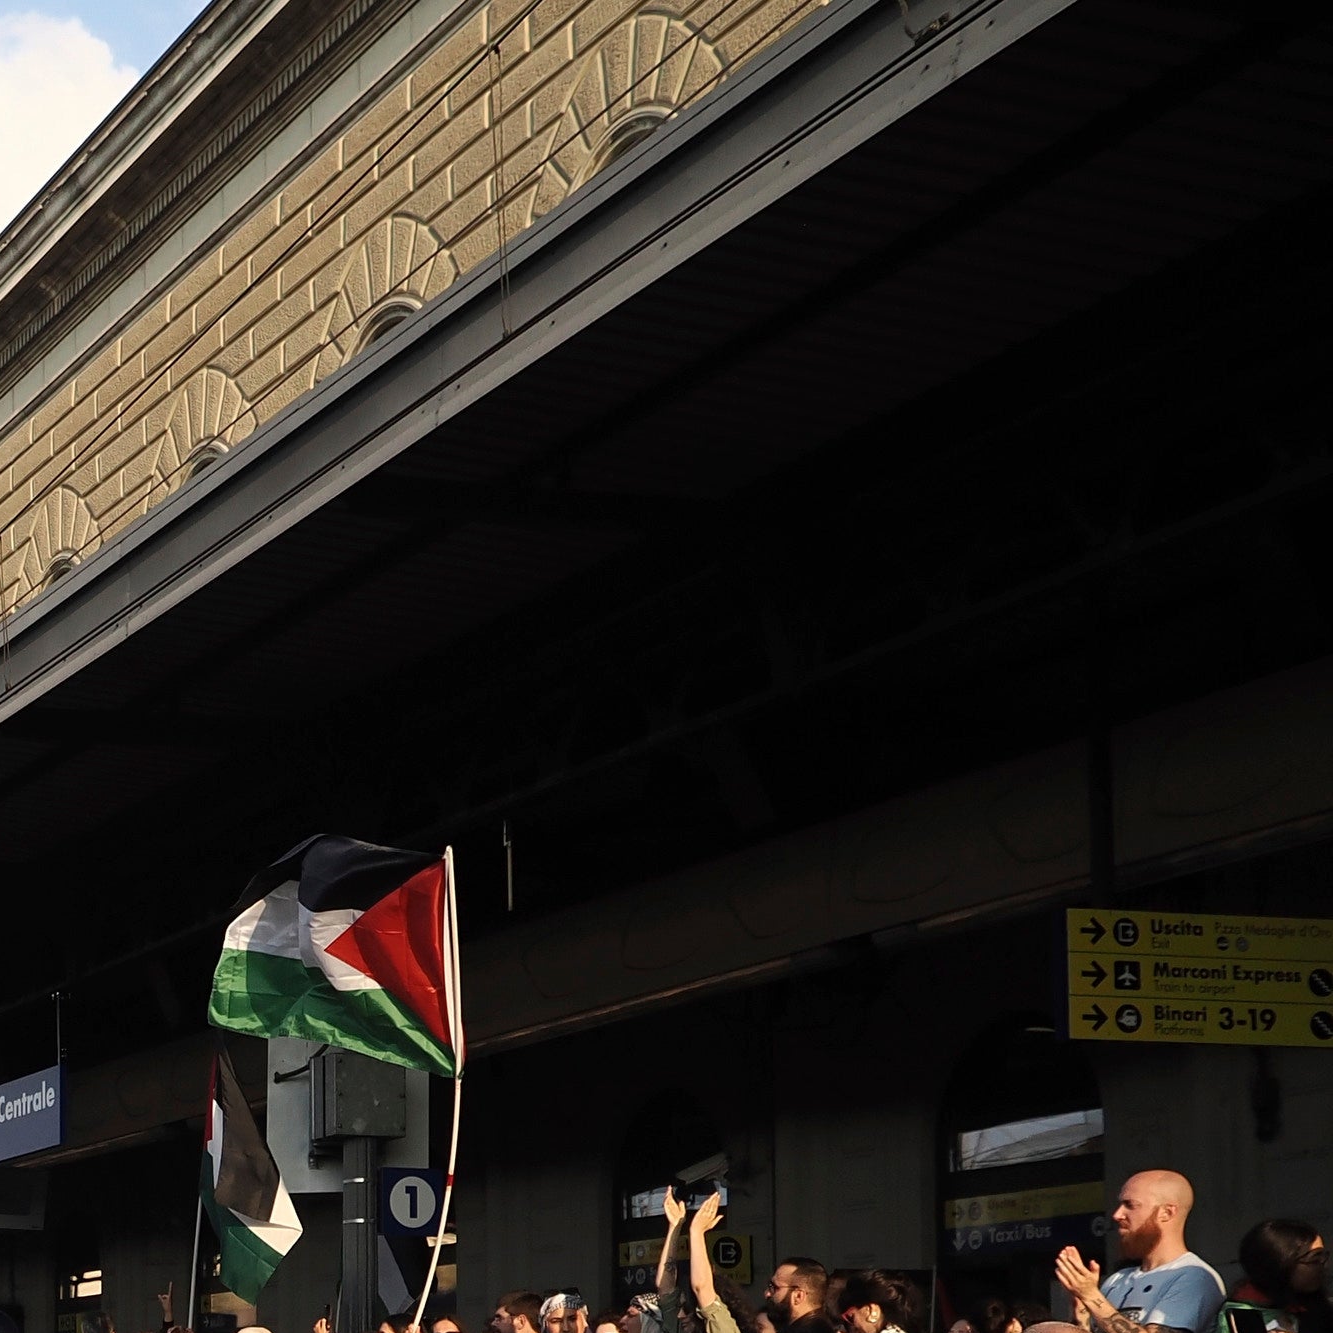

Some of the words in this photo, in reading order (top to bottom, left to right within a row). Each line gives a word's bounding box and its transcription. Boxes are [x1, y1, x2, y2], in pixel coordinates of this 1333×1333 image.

[1150, 919, 1204, 937] Uscita
[1153, 962, 1227, 980] Marconi
[1233, 965, 1302, 985] Express
[1154, 1005, 1207, 1022] Binari
[1219, 1007, 1276, 1031] 3-19
[405, 1186, 418, 1218] 1
[988, 1223, 1052, 1244] Taxi/Bus
